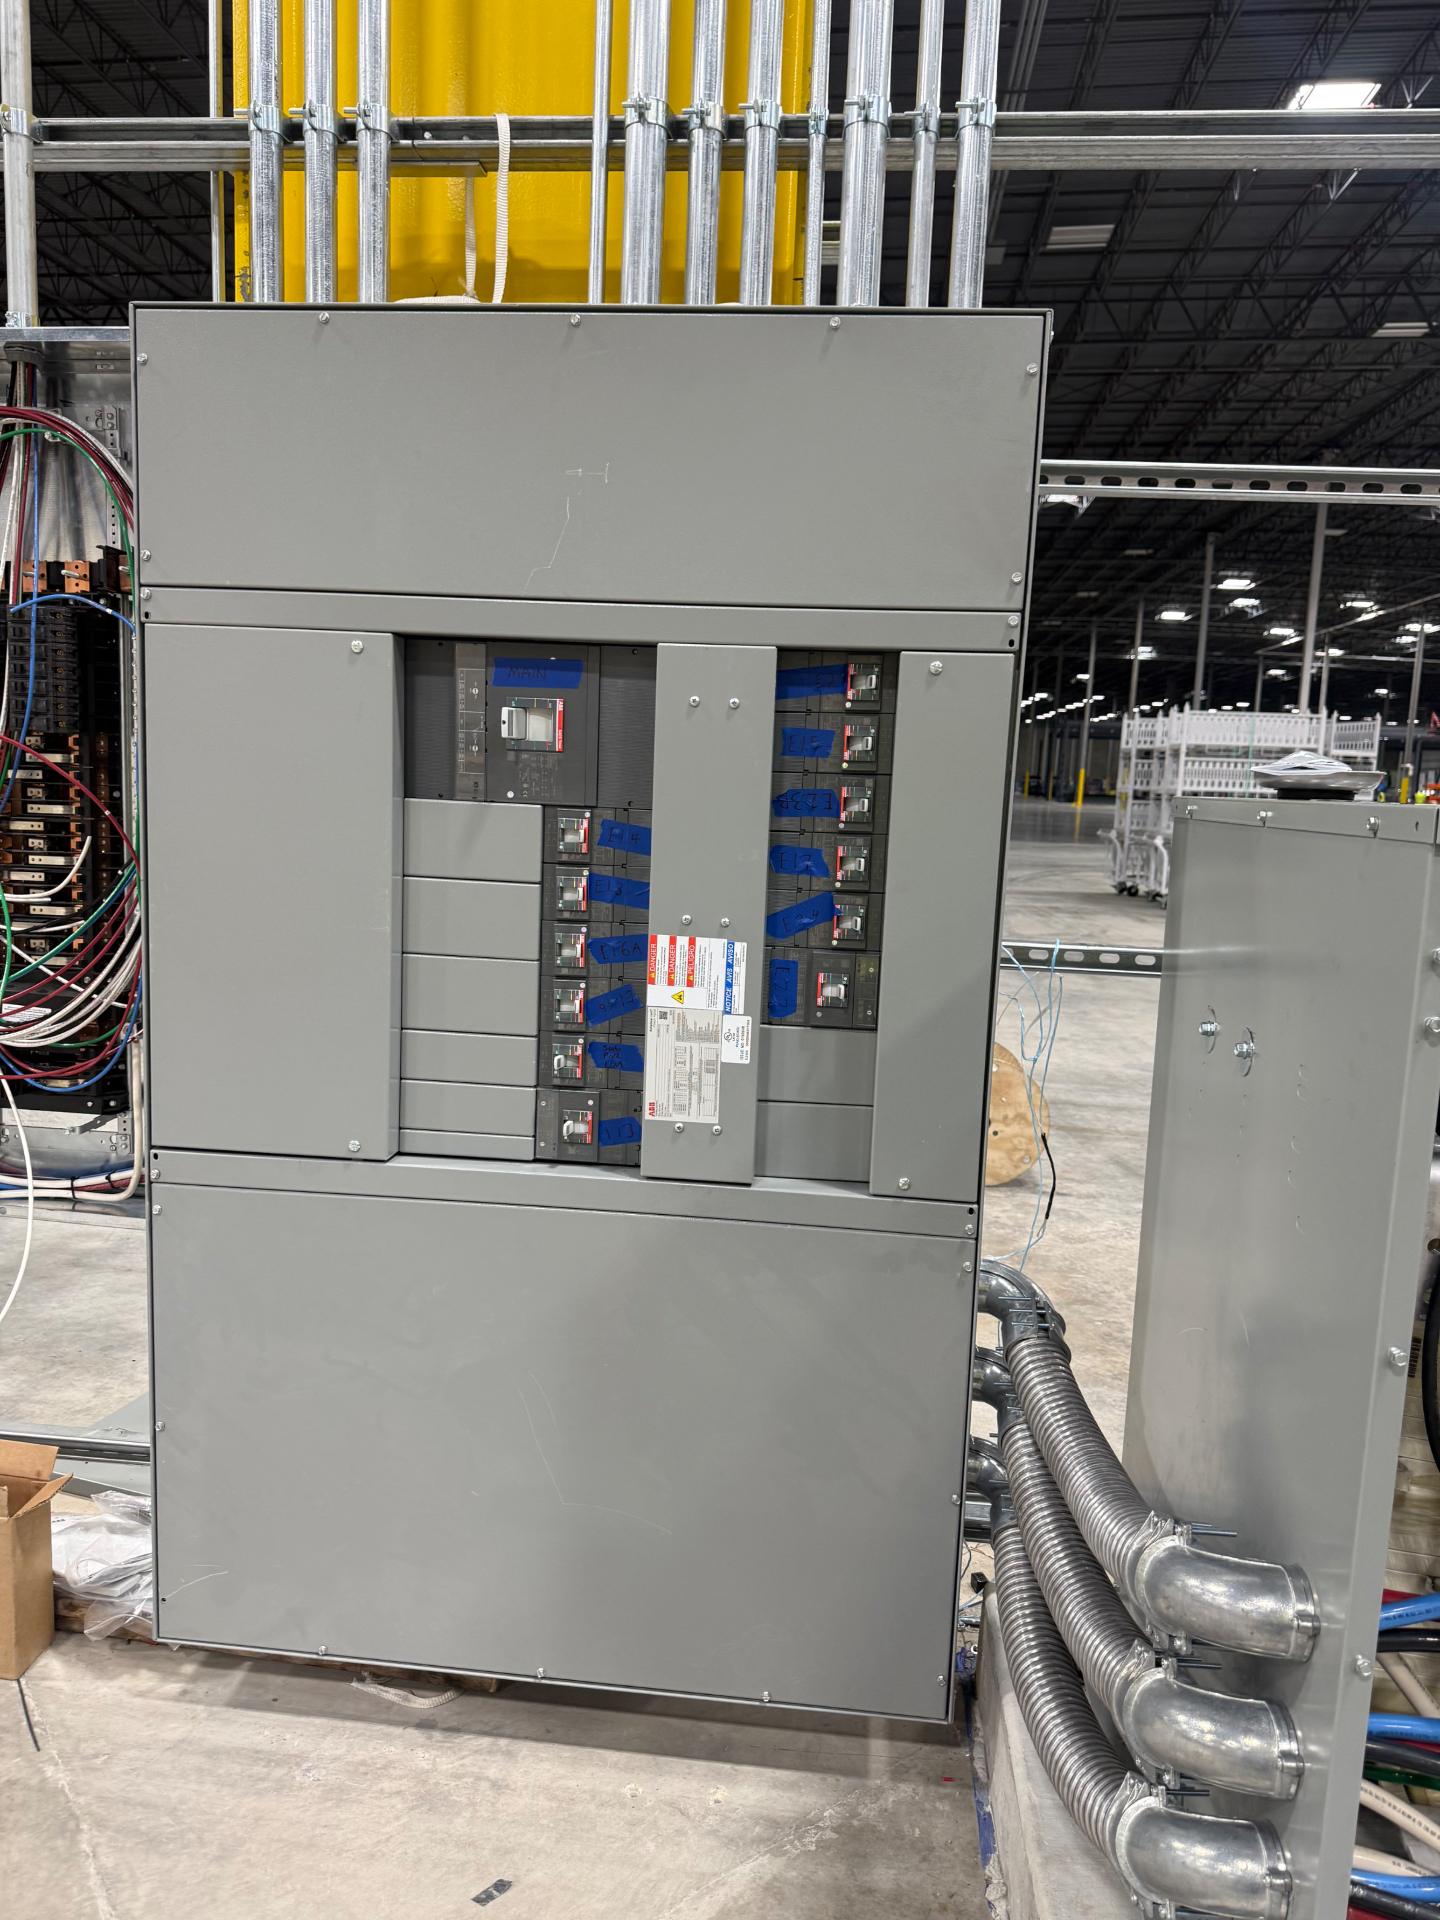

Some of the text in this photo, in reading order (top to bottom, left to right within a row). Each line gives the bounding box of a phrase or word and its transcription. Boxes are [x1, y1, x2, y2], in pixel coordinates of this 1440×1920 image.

[507, 666, 547, 680] MAIN
[594, 880, 623, 896] E1.3
[649, 943, 657, 972] DANGER
[726, 967, 734, 983] AVIS
[648, 1101, 656, 1118] ABB
